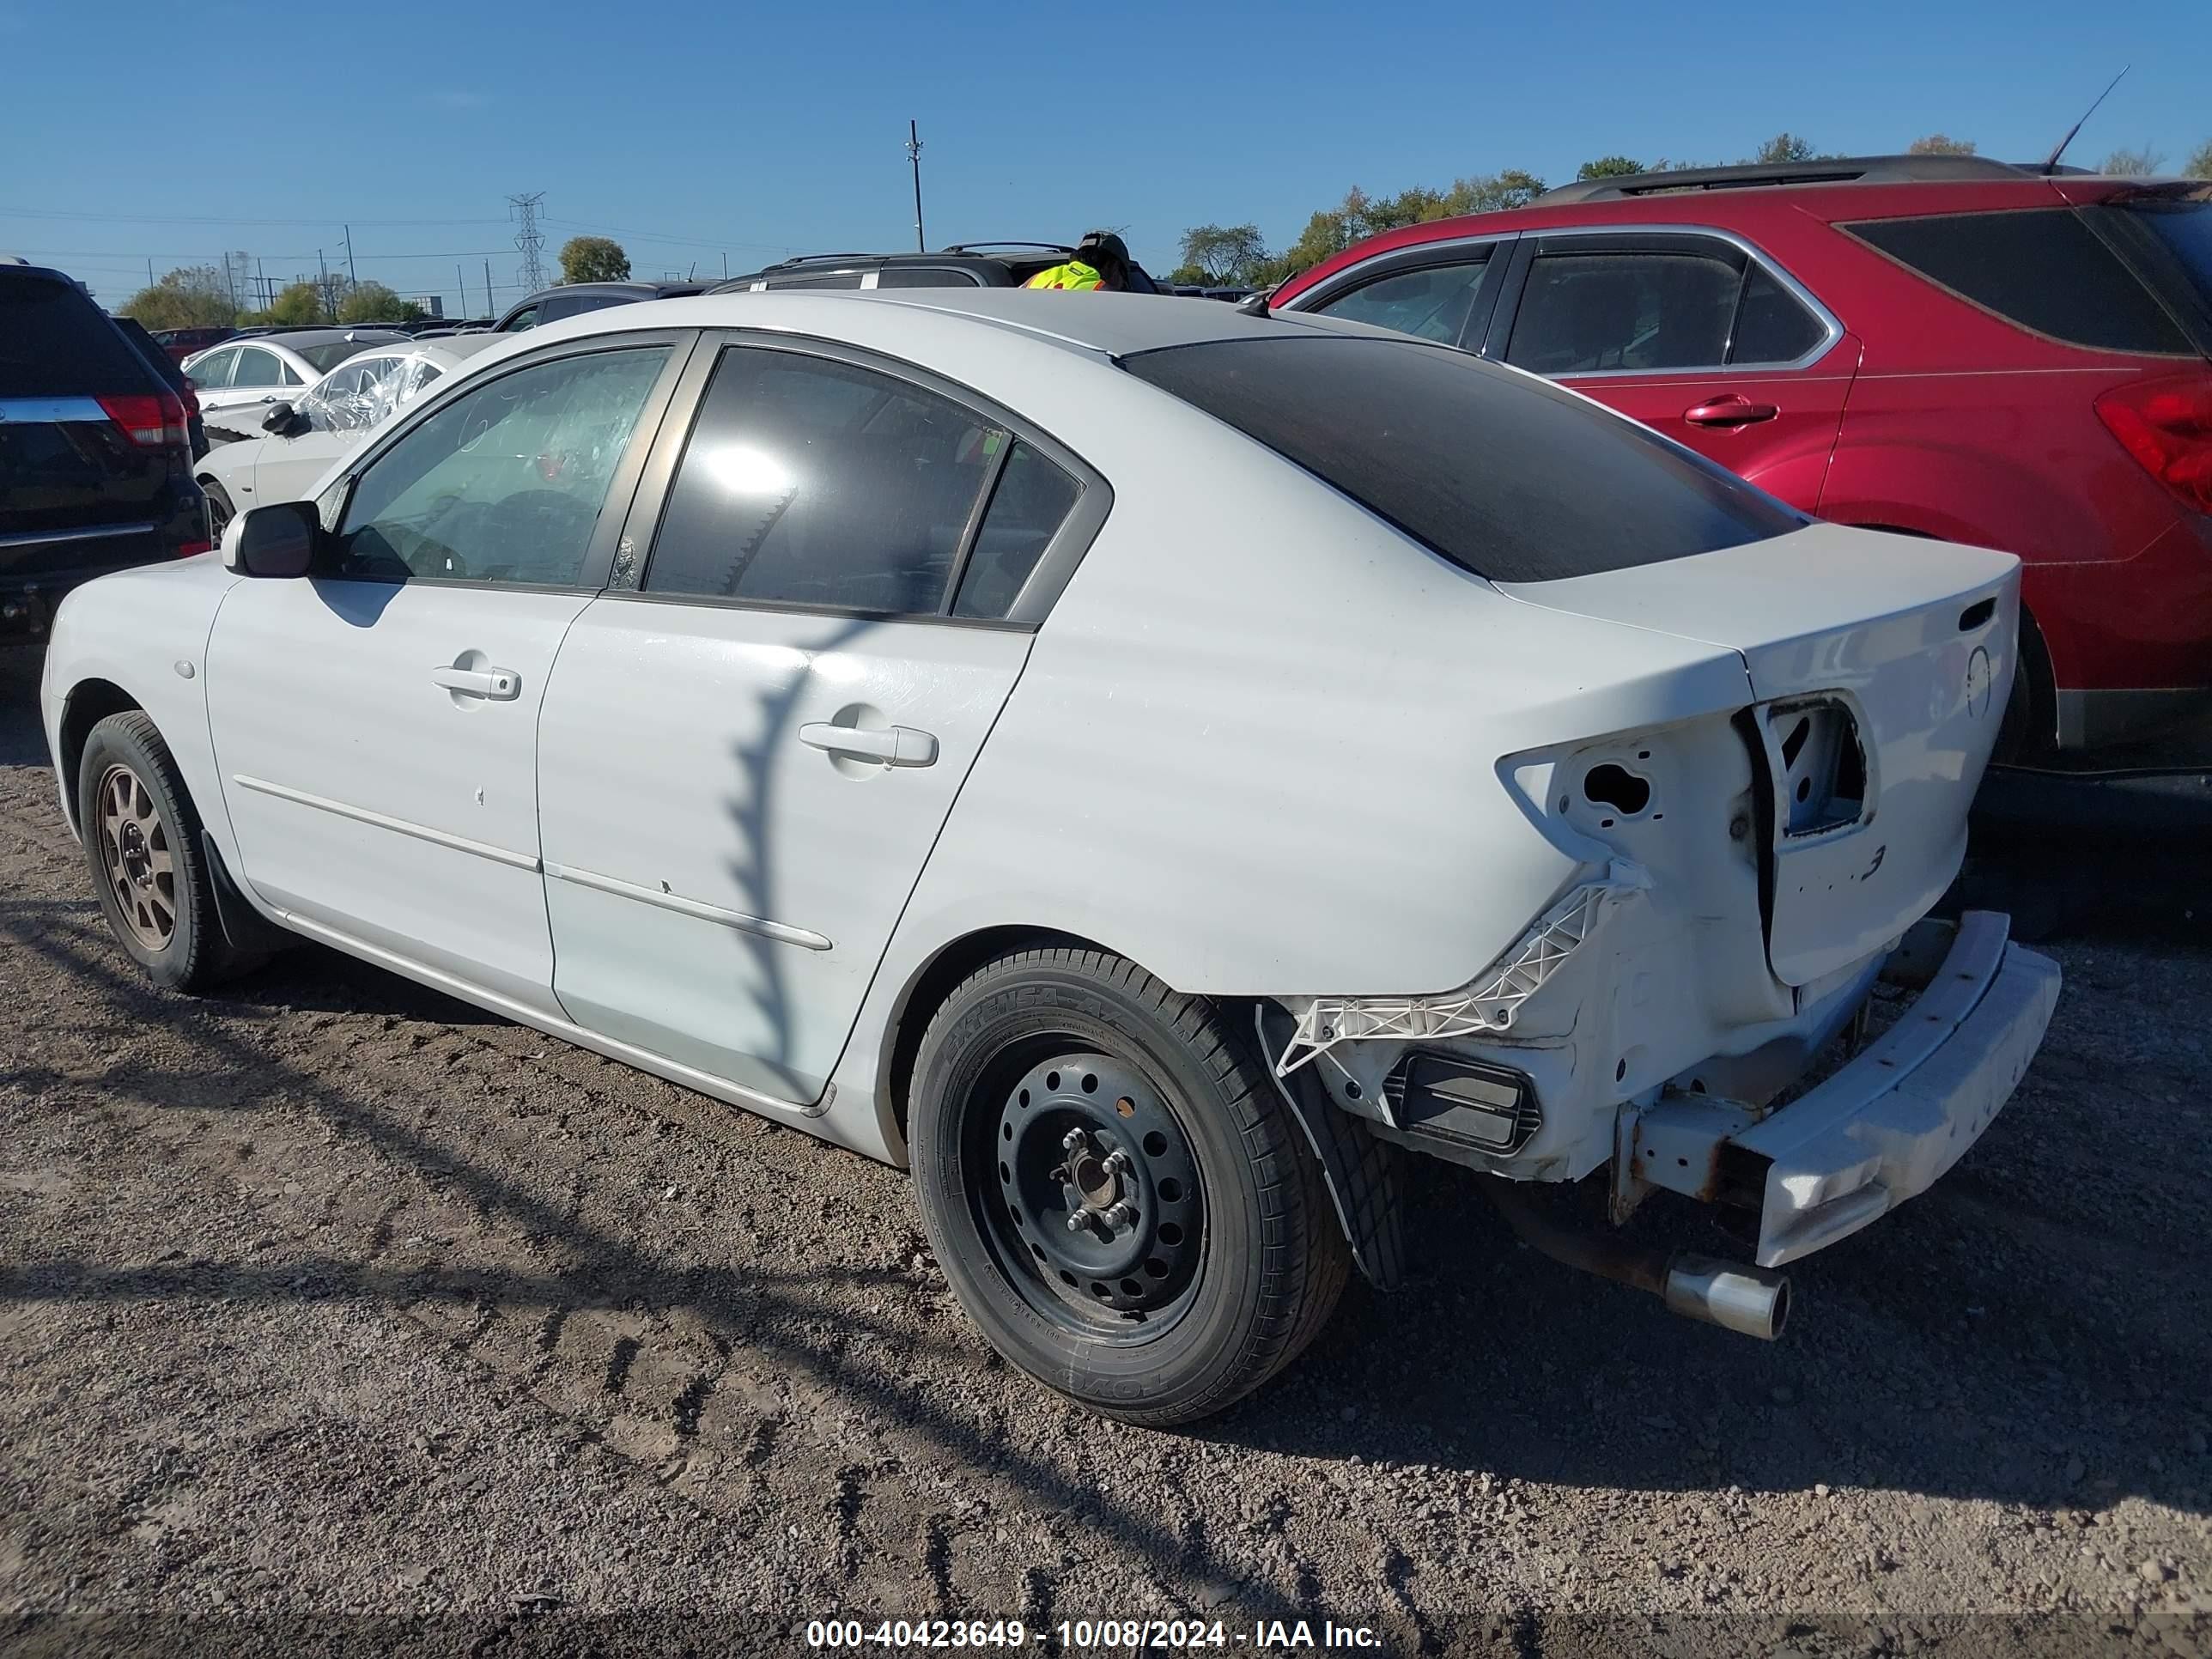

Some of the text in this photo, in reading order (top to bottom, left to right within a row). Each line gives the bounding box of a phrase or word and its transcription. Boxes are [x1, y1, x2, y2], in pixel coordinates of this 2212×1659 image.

[1861, 844, 1887, 882] 3
[947, 987, 1058, 1060] EXTENSA
[1055, 1368, 1169, 1398] TOYO
